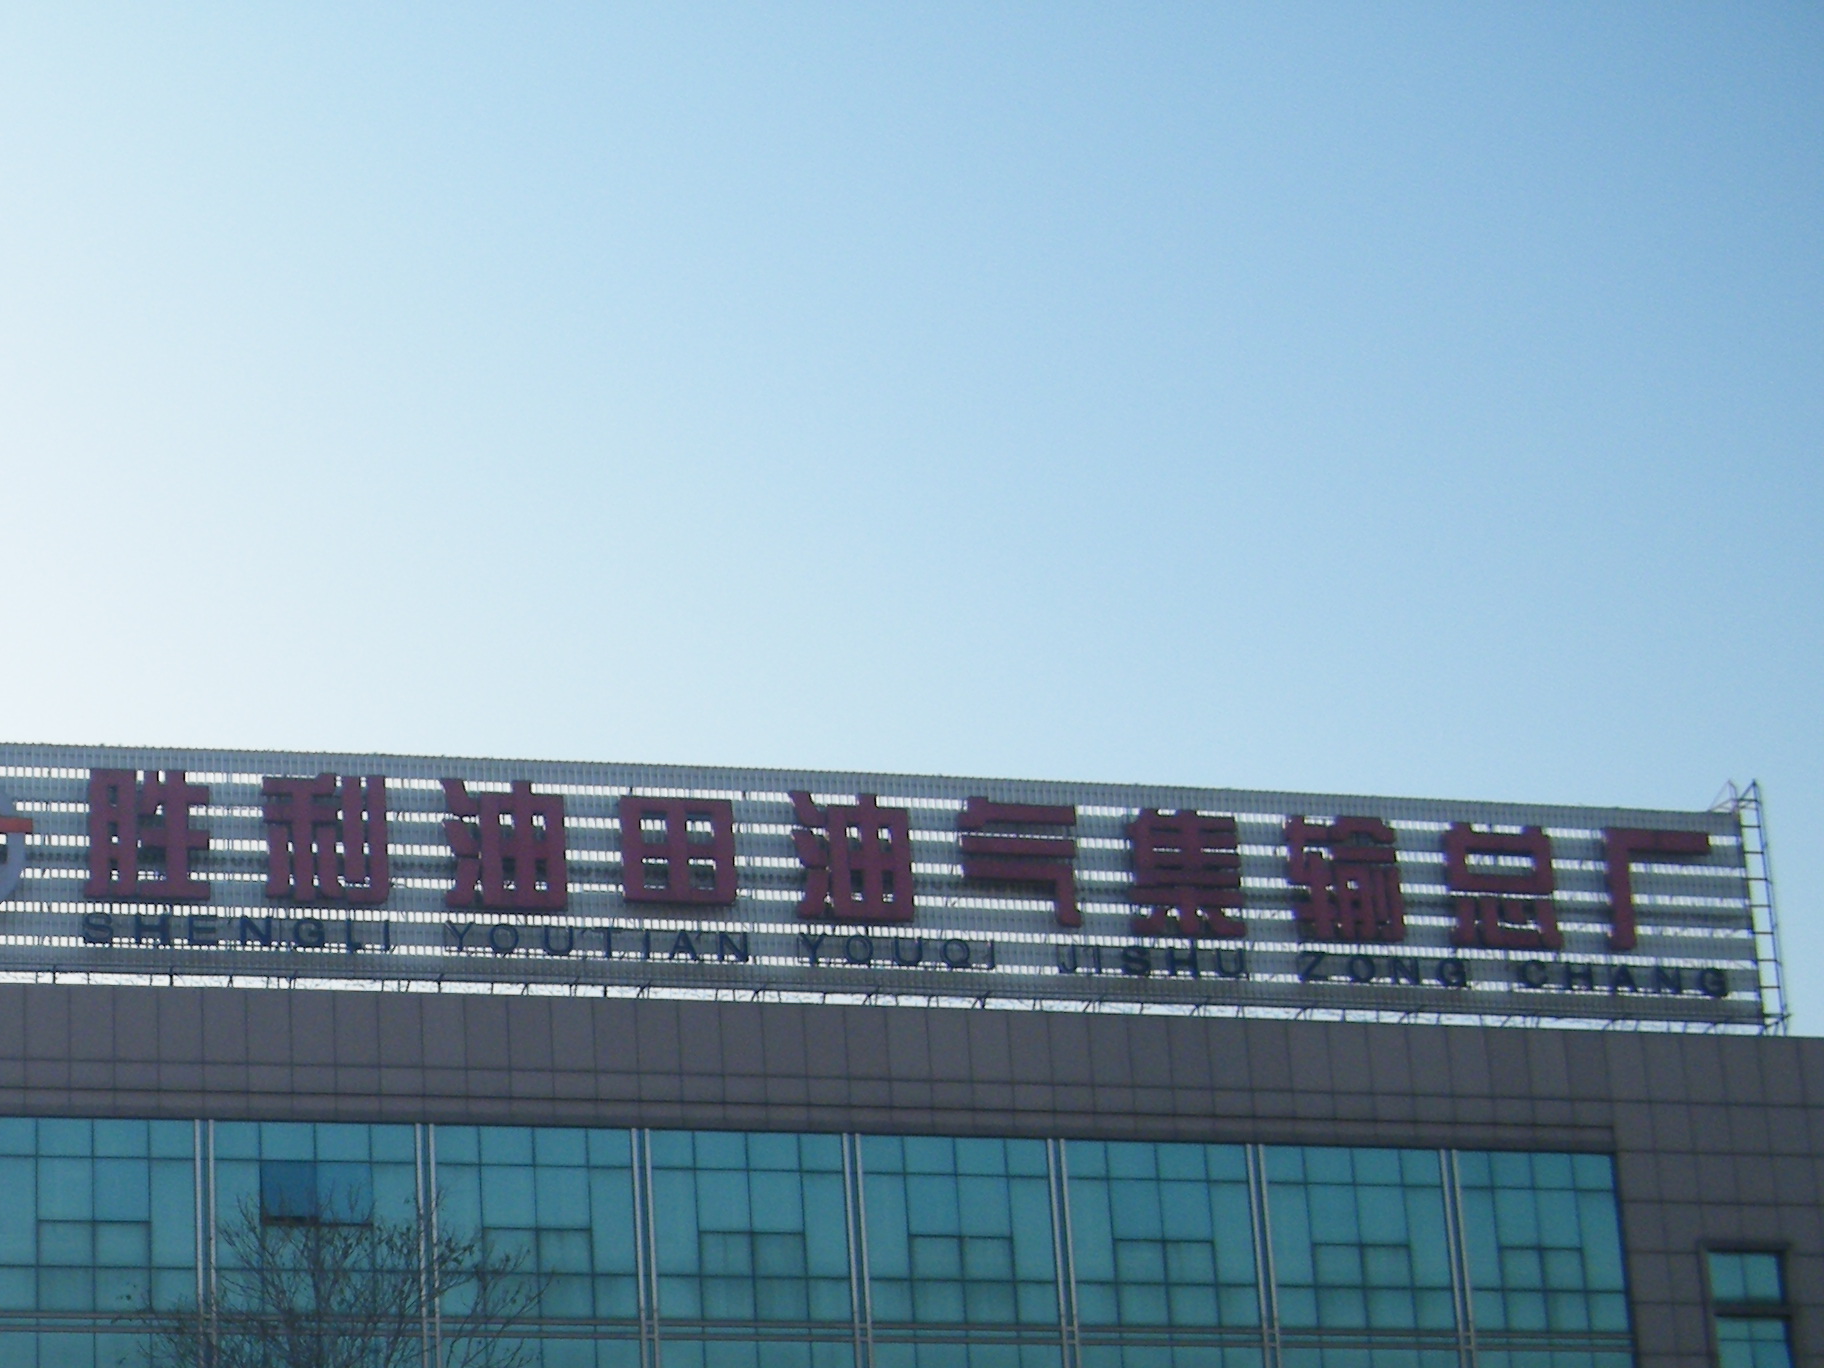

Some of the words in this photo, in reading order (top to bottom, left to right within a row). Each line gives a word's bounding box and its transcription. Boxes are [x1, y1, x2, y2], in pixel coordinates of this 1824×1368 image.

[84, 768, 1711, 952] 胜利油田油气集输总厂
[81, 911, 393, 953] SHENGLI
[442, 919, 750, 963] YOUTIAN
[796, 931, 996, 971] YOUQI
[1056, 940, 1249, 980] JISHU
[1297, 950, 1470, 989] ZONG
[1515, 959, 1729, 999] CHANG
